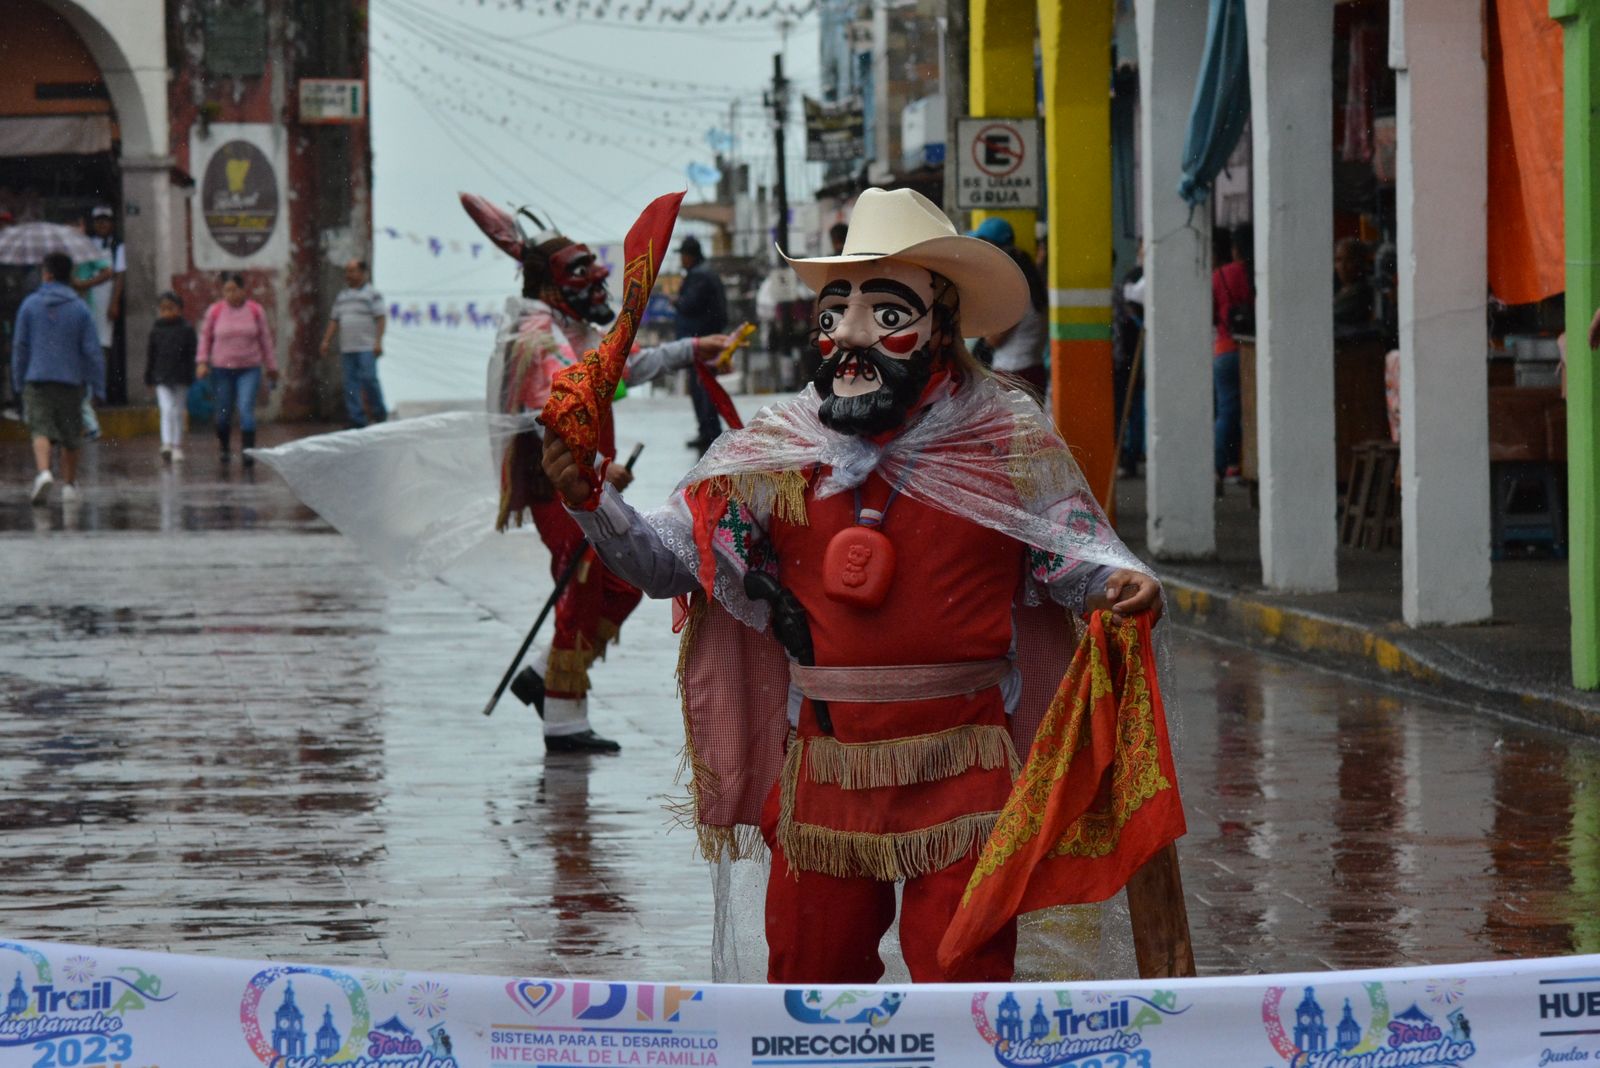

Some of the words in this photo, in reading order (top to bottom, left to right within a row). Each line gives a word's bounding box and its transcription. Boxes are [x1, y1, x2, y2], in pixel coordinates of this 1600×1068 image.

[963, 177, 981, 188] SE
[969, 190, 1020, 203] GRUA
[33, 982, 111, 1013] Trail
[1053, 1001, 1129, 1036] Trail
[367, 1031, 423, 1059] Feria
[491, 1031, 553, 1046] SISTEMA
[558, 1034, 597, 1047] PARA
[601, 1036, 618, 1048] EL
[622, 1036, 718, 1049] DESARROLLO
[752, 1028, 896, 1056] DIRECCIÓN
[901, 1033, 935, 1053] DE
[1002, 1030, 1142, 1063] Hueytamalco
[1387, 1021, 1442, 1048] Feria
[32, 1034, 132, 1068] 2023
[491, 1046, 583, 1063] INTEGRAL
[588, 1050, 612, 1064] DE
[617, 1051, 641, 1065] LA
[646, 1051, 718, 1067] FAMILIA
